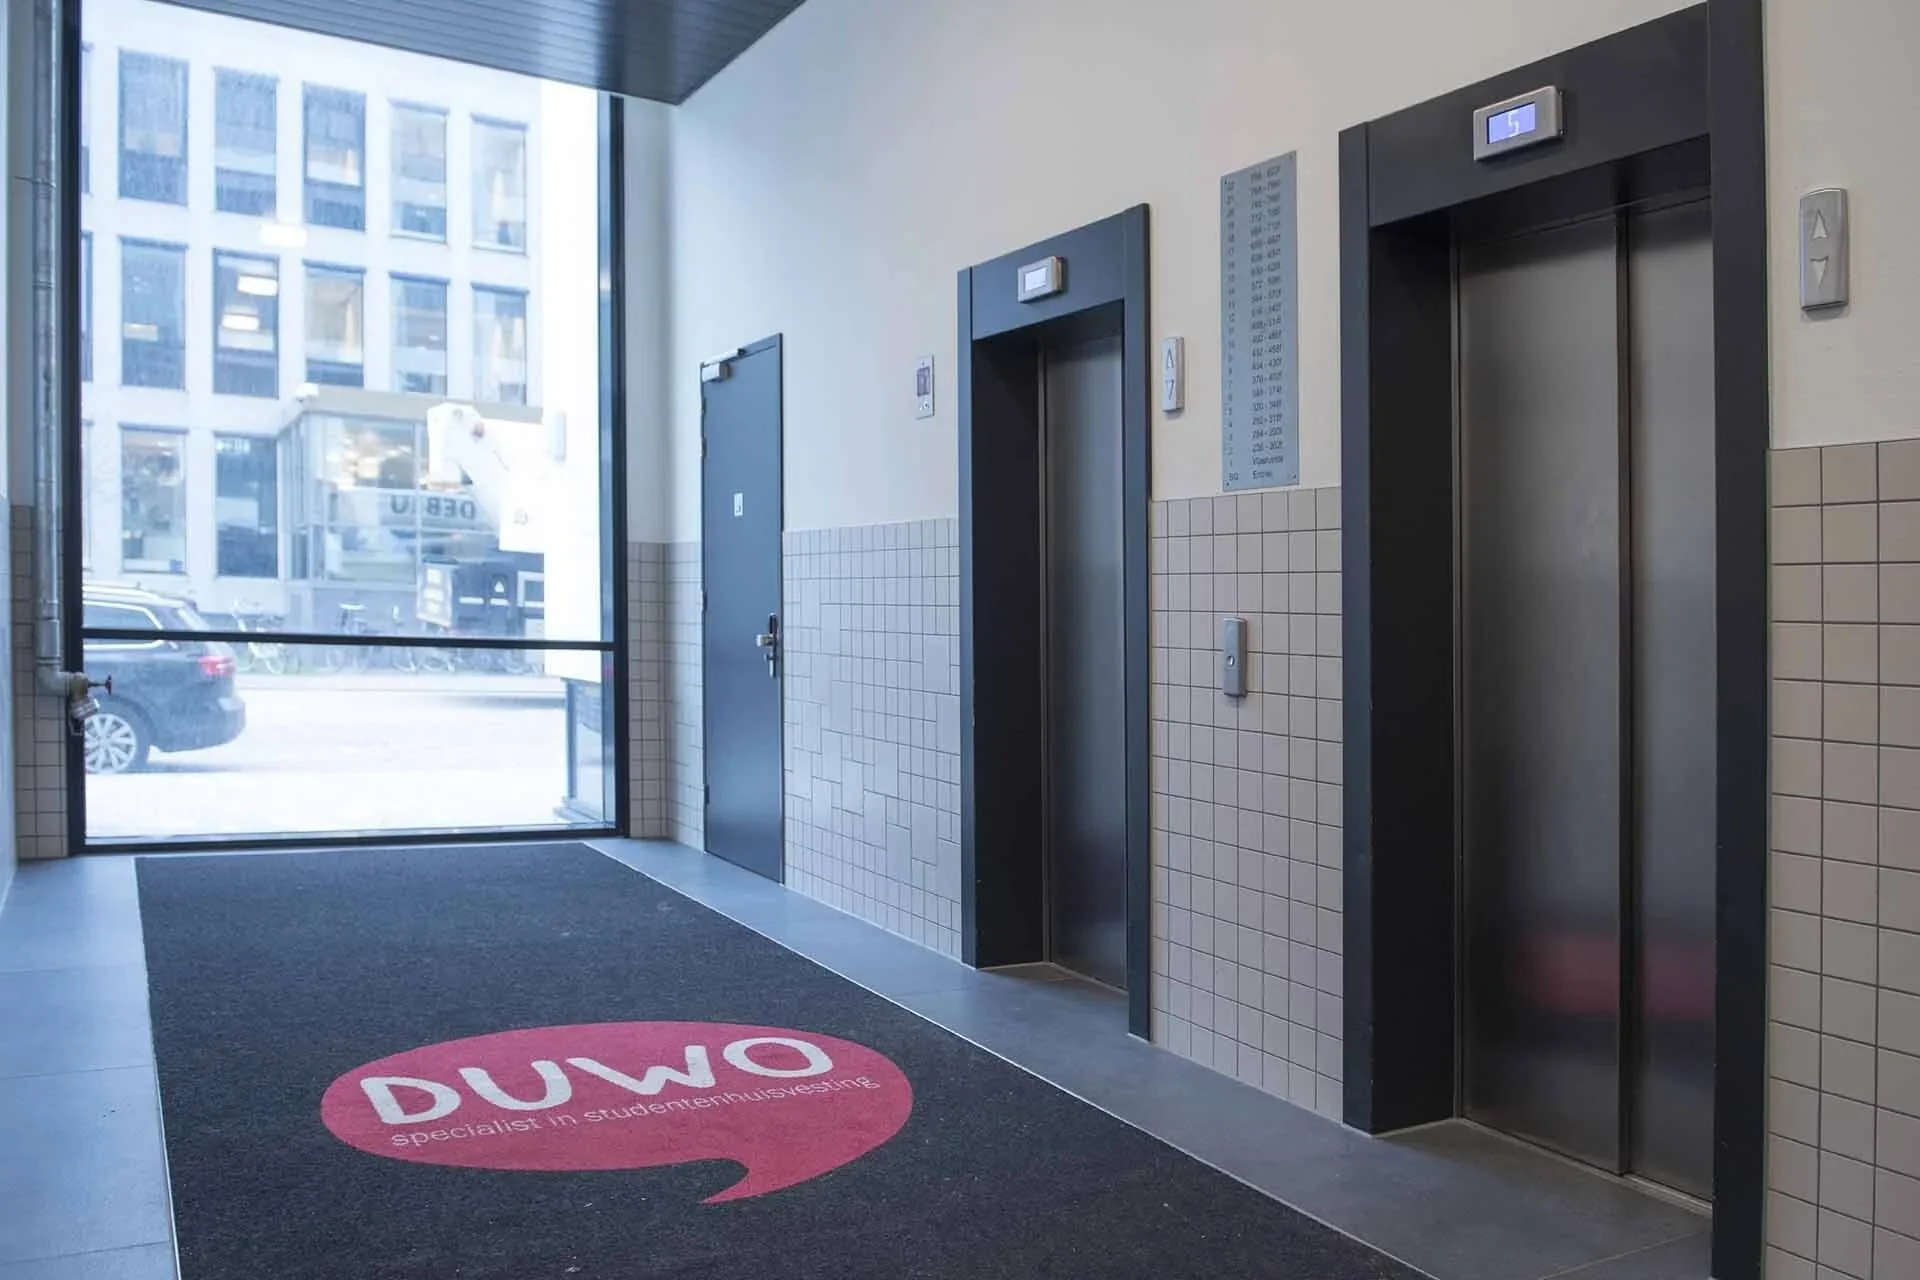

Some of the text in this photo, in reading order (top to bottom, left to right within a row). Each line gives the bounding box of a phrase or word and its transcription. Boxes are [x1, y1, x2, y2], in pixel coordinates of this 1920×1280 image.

[360, 1037, 833, 1124] DUWO
[391, 1075, 881, 1148] specialist in studentenhuisvesting
